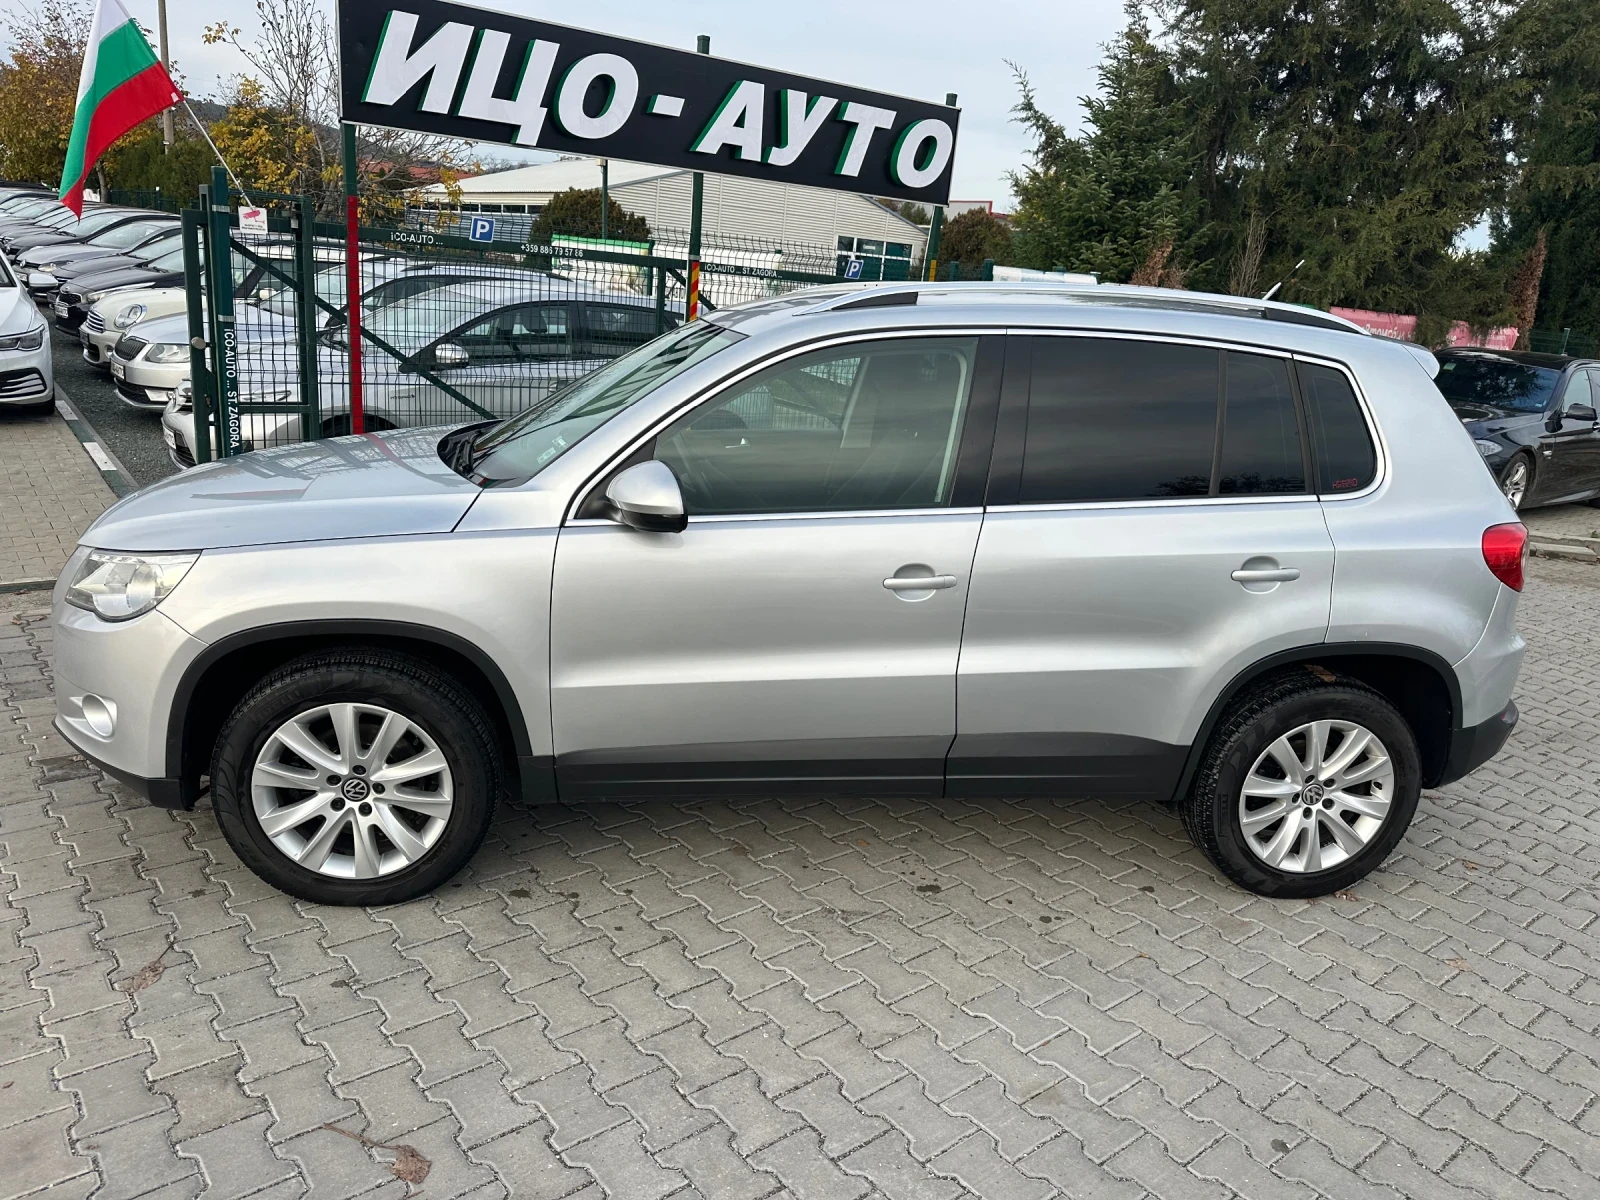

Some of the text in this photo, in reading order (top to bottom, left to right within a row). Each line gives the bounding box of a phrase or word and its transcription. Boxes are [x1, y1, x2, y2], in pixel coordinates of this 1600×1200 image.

[475, 220, 490, 239] P
[848, 262, 860, 277] P
[228, 406, 240, 448] ZAGORA
